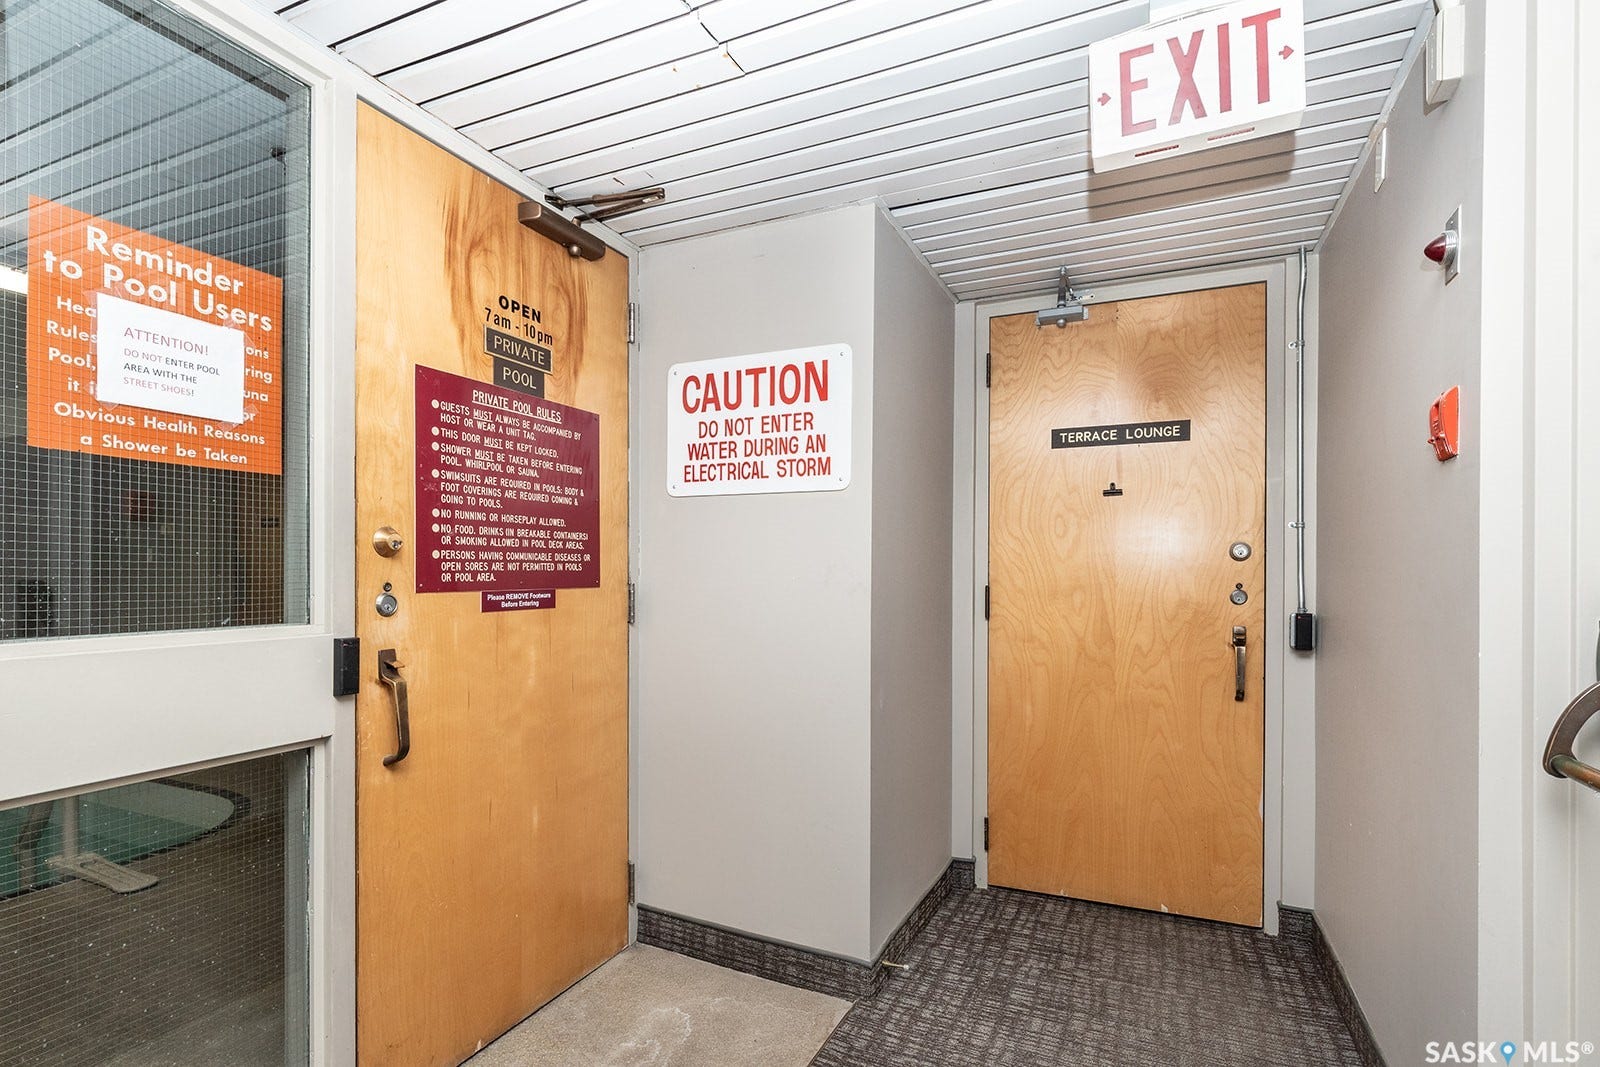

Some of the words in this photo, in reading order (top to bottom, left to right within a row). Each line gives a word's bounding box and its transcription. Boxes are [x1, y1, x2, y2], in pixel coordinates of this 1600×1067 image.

[1120, 8, 1281, 136] EXIT
[87, 226, 244, 295] Reminder
[43, 250, 83, 279] to
[104, 264, 176, 306] Pool
[193, 289, 272, 332] Users
[499, 295, 541, 323] OPEN
[57, 296, 97, 317] Hea
[245, 346, 269, 359] ons
[47, 320, 97, 343] Rules
[245, 366, 272, 384] ring
[124, 328, 208, 356] ATTENTION!
[494, 336, 544, 365] PRIVATE
[49, 347, 96, 371] Pool,
[243, 390, 268, 401] una
[124, 348, 139, 358] DO
[142, 352, 162, 362] NOT
[166, 357, 194, 370] ENTER
[197, 364, 220, 376] POOL
[124, 362, 150, 374] AREA
[152, 368, 177, 380] WITH
[180, 374, 197, 384] THE
[68, 378, 79, 391] it
[124, 377, 158, 390] STREET
[161, 384, 194, 396] SHOES!
[503, 366, 536, 389] POOL
[682, 359, 828, 414] CAUTION
[473, 390, 508, 409] PRIVATE
[513, 400, 532, 416] POOL
[536, 406, 562, 422] RULES
[54, 402, 135, 426] Obvious
[144, 415, 197, 435] Health
[204, 425, 265, 445] Reasons
[440, 401, 470, 416] GUESTS
[474, 408, 492, 420] MUST
[495, 414, 520, 426] ALWAYS
[522, 420, 530, 429] BE
[533, 423, 572, 438] ACCOMPANIED
[574, 432, 582, 440] BY
[440, 413, 460, 425] HOST
[464, 418, 474, 428] OR
[477, 421, 496, 432] WEAR
[498, 426, 503, 434] A
[506, 427, 520, 436] UNIT
[698, 420, 718, 438] DO
[724, 417, 754, 436] NOT
[761, 412, 814, 434] ENTER
[440, 428, 458, 440] THIS
[462, 432, 480, 444] DOOR
[484, 437, 502, 448] MUST
[506, 441, 514, 450] BE
[517, 443, 532, 454] KEPT
[688, 440, 737, 460] WATER
[744, 436, 799, 457] DURING
[806, 434, 826, 453] AN
[1060, 430, 1117, 443] TERRACE
[1126, 426, 1180, 439] LOUNGE
[80, 436, 92, 445] a
[102, 434, 168, 455] Shower
[176, 443, 196, 458] be
[204, 448, 247, 464] Taken
[440, 443, 472, 456] SHOWER
[475, 449, 494, 460] MUST
[497, 454, 505, 462] BE
[509, 455, 528, 465] TAKEN
[531, 459, 554, 470] BEFORE
[556, 464, 582, 475] ENTERING
[465, 459, 503, 472] WHIRLPOOL
[506, 466, 515, 474] OR
[684, 460, 769, 482] ELECTRICAL
[777, 457, 831, 478] STORM
[440, 470, 481, 484] SWIMSUITS
[484, 476, 497, 486] ARE
[500, 478, 531, 490] REQUIRED
[534, 483, 540, 491] IN
[440, 482, 460, 492] FOOT
[463, 485, 502, 498] COVERINGS
[504, 490, 517, 500] ARE
[520, 492, 550, 502] REQUIRED
[441, 494, 464, 504] GOING
[466, 496, 476, 506] TO
[479, 498, 503, 508] POOLS.
[440, 509, 452, 518] NO
[454, 510, 486, 521] RUNNING
[489, 513, 498, 522] OR
[502, 514, 537, 524] HORSEPLAY
[539, 518, 566, 527] ALLOWED.
[440, 524, 452, 533] NO
[479, 526, 504, 536] DRINKS
[517, 528, 551, 538] BREAKABLE
[440, 550, 476, 560] PERSONS
[479, 552, 504, 560] HAVING
[506, 552, 552, 561] COMMUNICABLE
[554, 553, 581, 561] DISEASES
[441, 536, 452, 545] OR
[455, 536, 487, 546] SMOKING
[490, 538, 520, 547] ALLOWED
[522, 539, 528, 547] IN
[531, 540, 546, 548] POOL
[548, 540, 564, 549] DECK
[441, 562, 461, 571] OPEN
[464, 562, 488, 570] SORES
[491, 562, 504, 571] ARE
[508, 562, 520, 570] NOT
[522, 562, 554, 571] PERMITTED
[564, 563, 582, 571] POOLS
[441, 573, 452, 582] OR
[454, 573, 474, 582] POOL
[476, 572, 496, 582] AREA.
